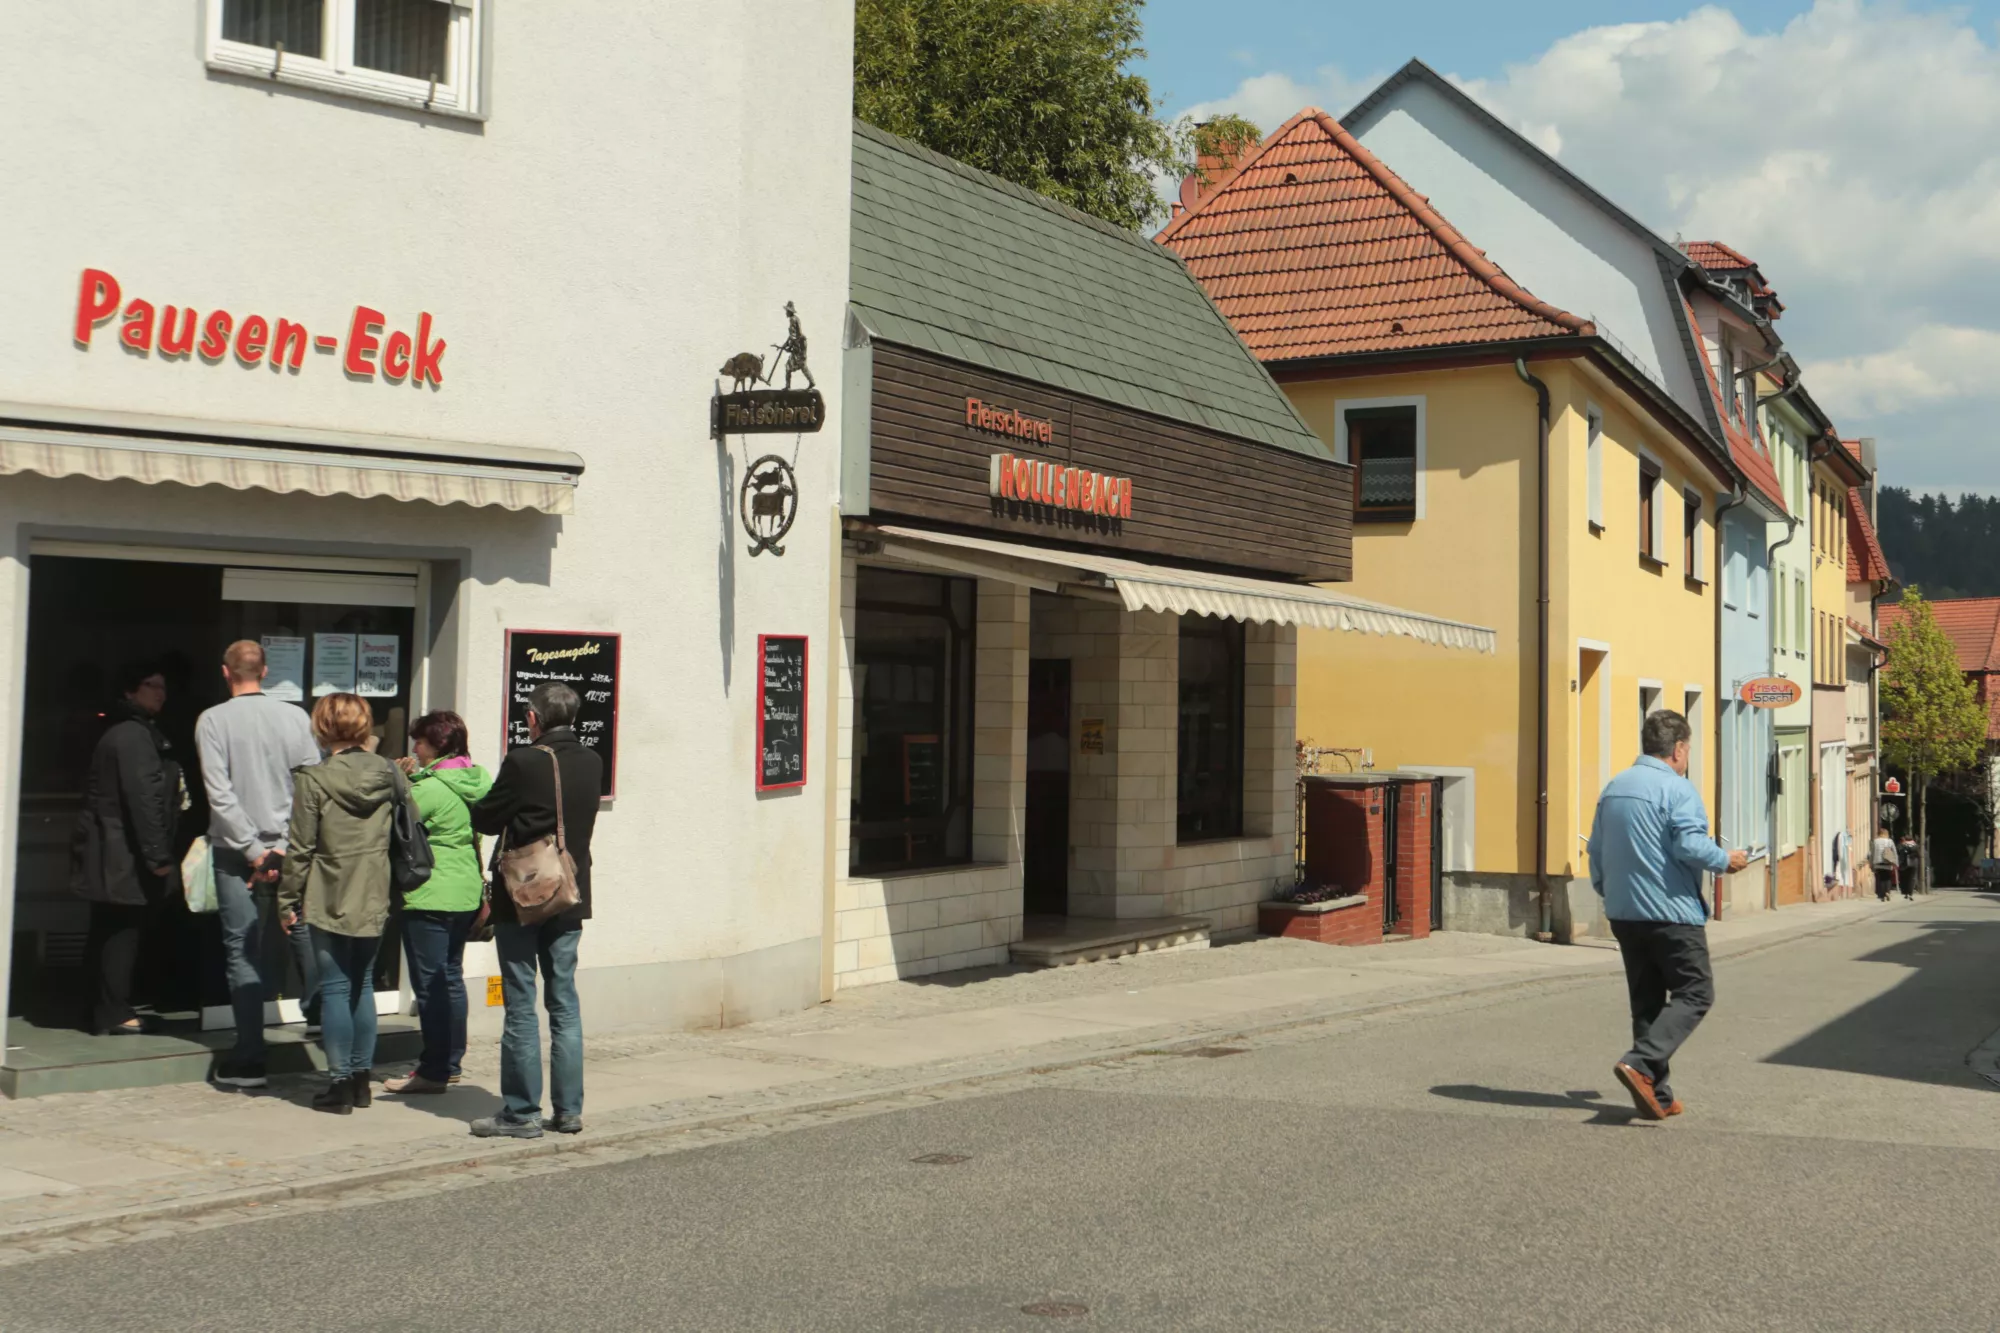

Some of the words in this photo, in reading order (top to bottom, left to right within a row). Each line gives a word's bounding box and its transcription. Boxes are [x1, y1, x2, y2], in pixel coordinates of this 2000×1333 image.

[74, 268, 447, 385] Pausen-Eck
[725, 398, 818, 426] Fleischerei
[966, 397, 1053, 442] Fleischerei
[999, 453, 1132, 519] HOLLENBACH
[364, 656, 391, 667] IMBISS
[526, 641, 600, 666] Tagesangebot
[1752, 689, 1793, 704] Specht
